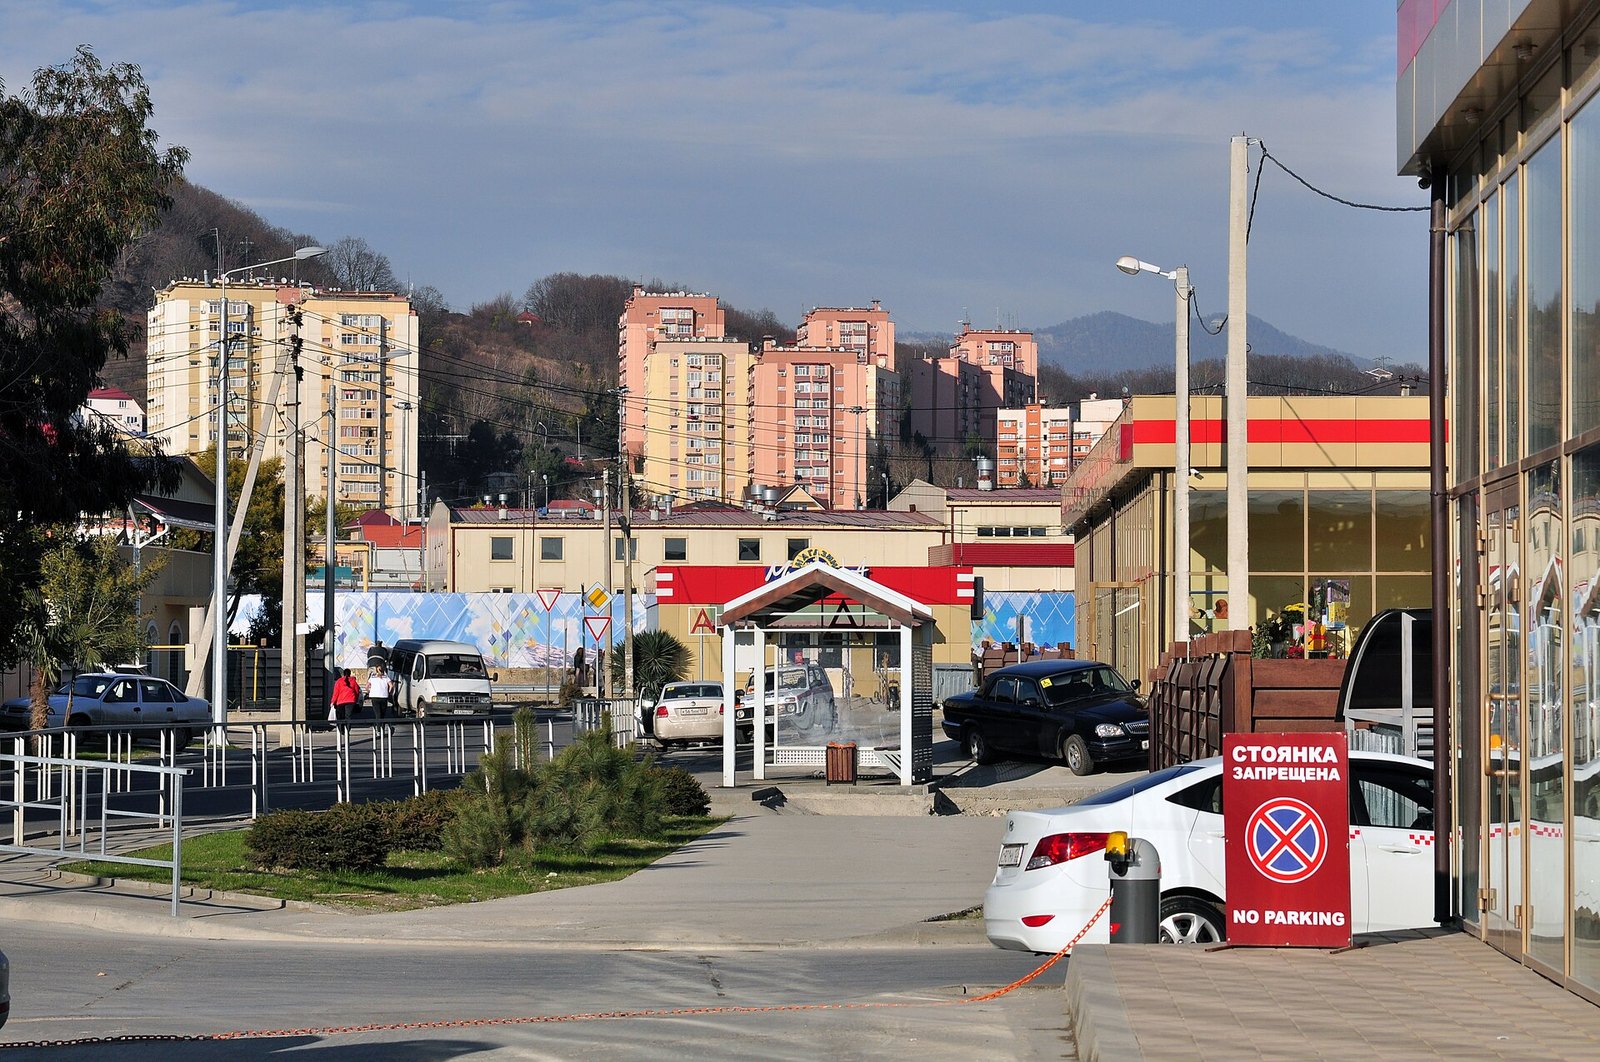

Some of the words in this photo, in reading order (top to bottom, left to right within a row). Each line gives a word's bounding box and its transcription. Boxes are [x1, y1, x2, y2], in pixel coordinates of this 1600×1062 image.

[794, 549, 839, 569] МАГАЗИН
[1232, 745, 1339, 763] СТОЯНКА
[1232, 767, 1340, 782] ЗАПРЕЩЕНА
[1233, 909, 1259, 924] NO
[1264, 910, 1345, 926] PARKING
